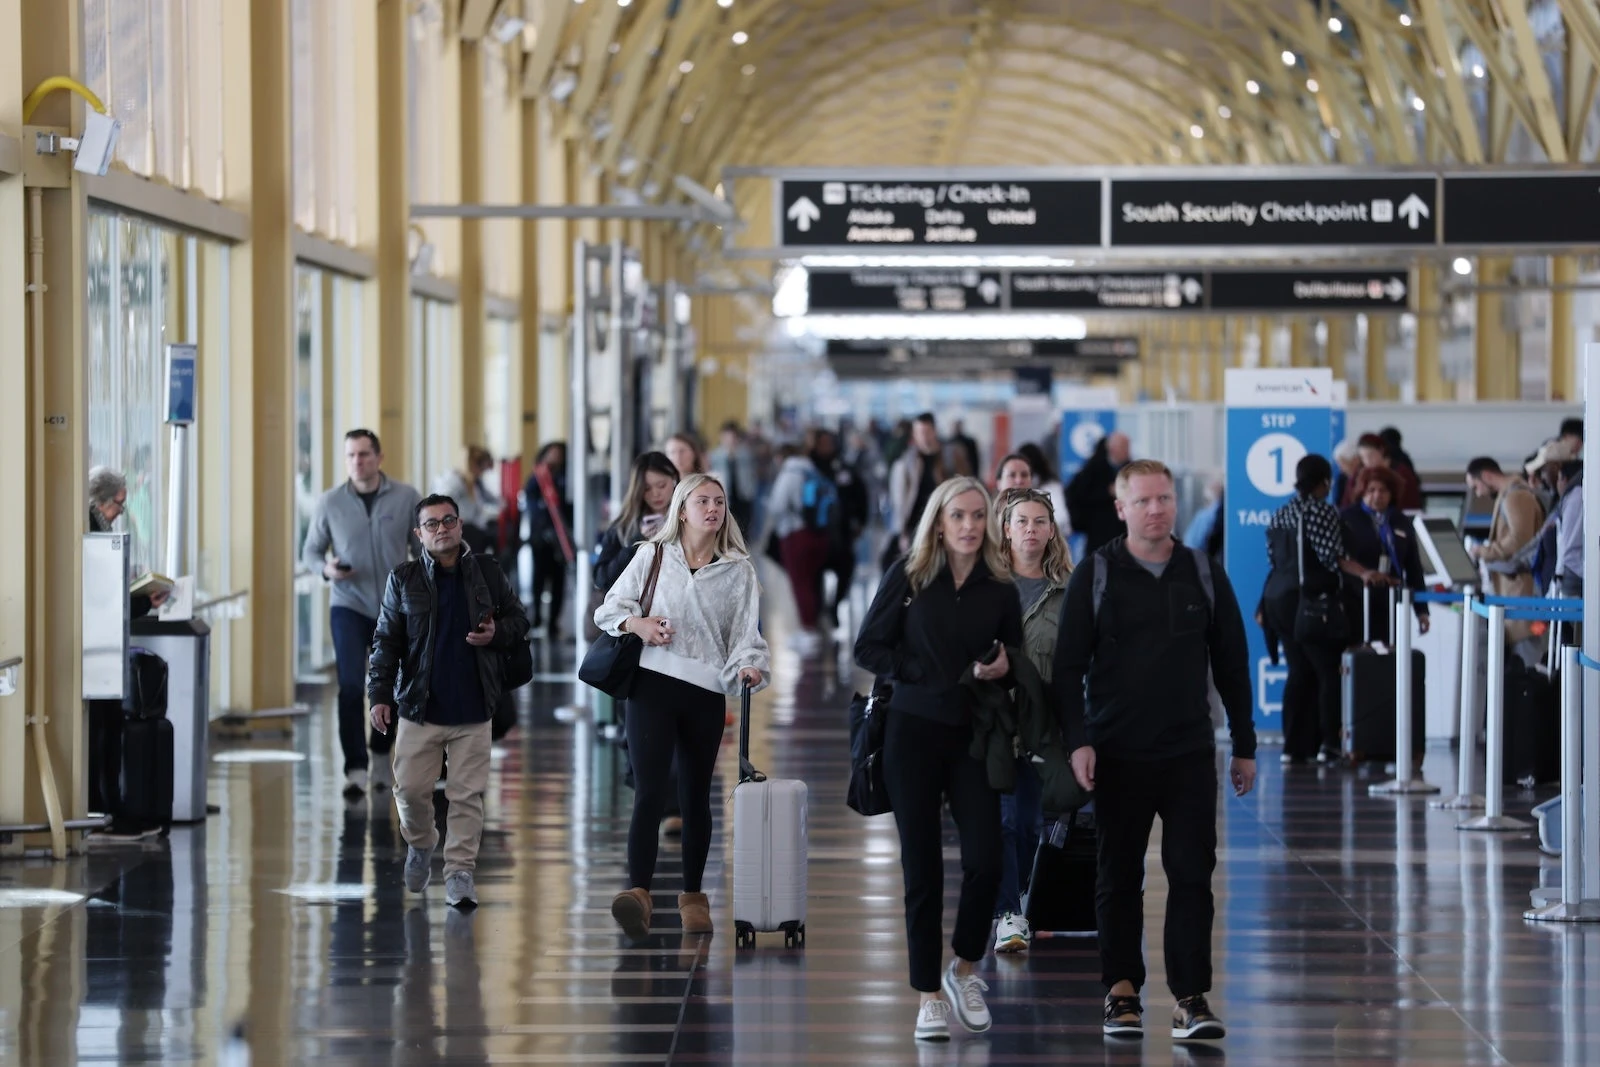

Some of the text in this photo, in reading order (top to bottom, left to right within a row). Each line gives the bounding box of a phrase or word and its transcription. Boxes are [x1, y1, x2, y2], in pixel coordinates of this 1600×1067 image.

[849, 183, 935, 208] Ticketing
[987, 208, 1037, 225] United
[1122, 200, 1368, 226] South Security Checkpoint
[1261, 413, 1296, 428] STEP
[1268, 446, 1283, 484] 1
